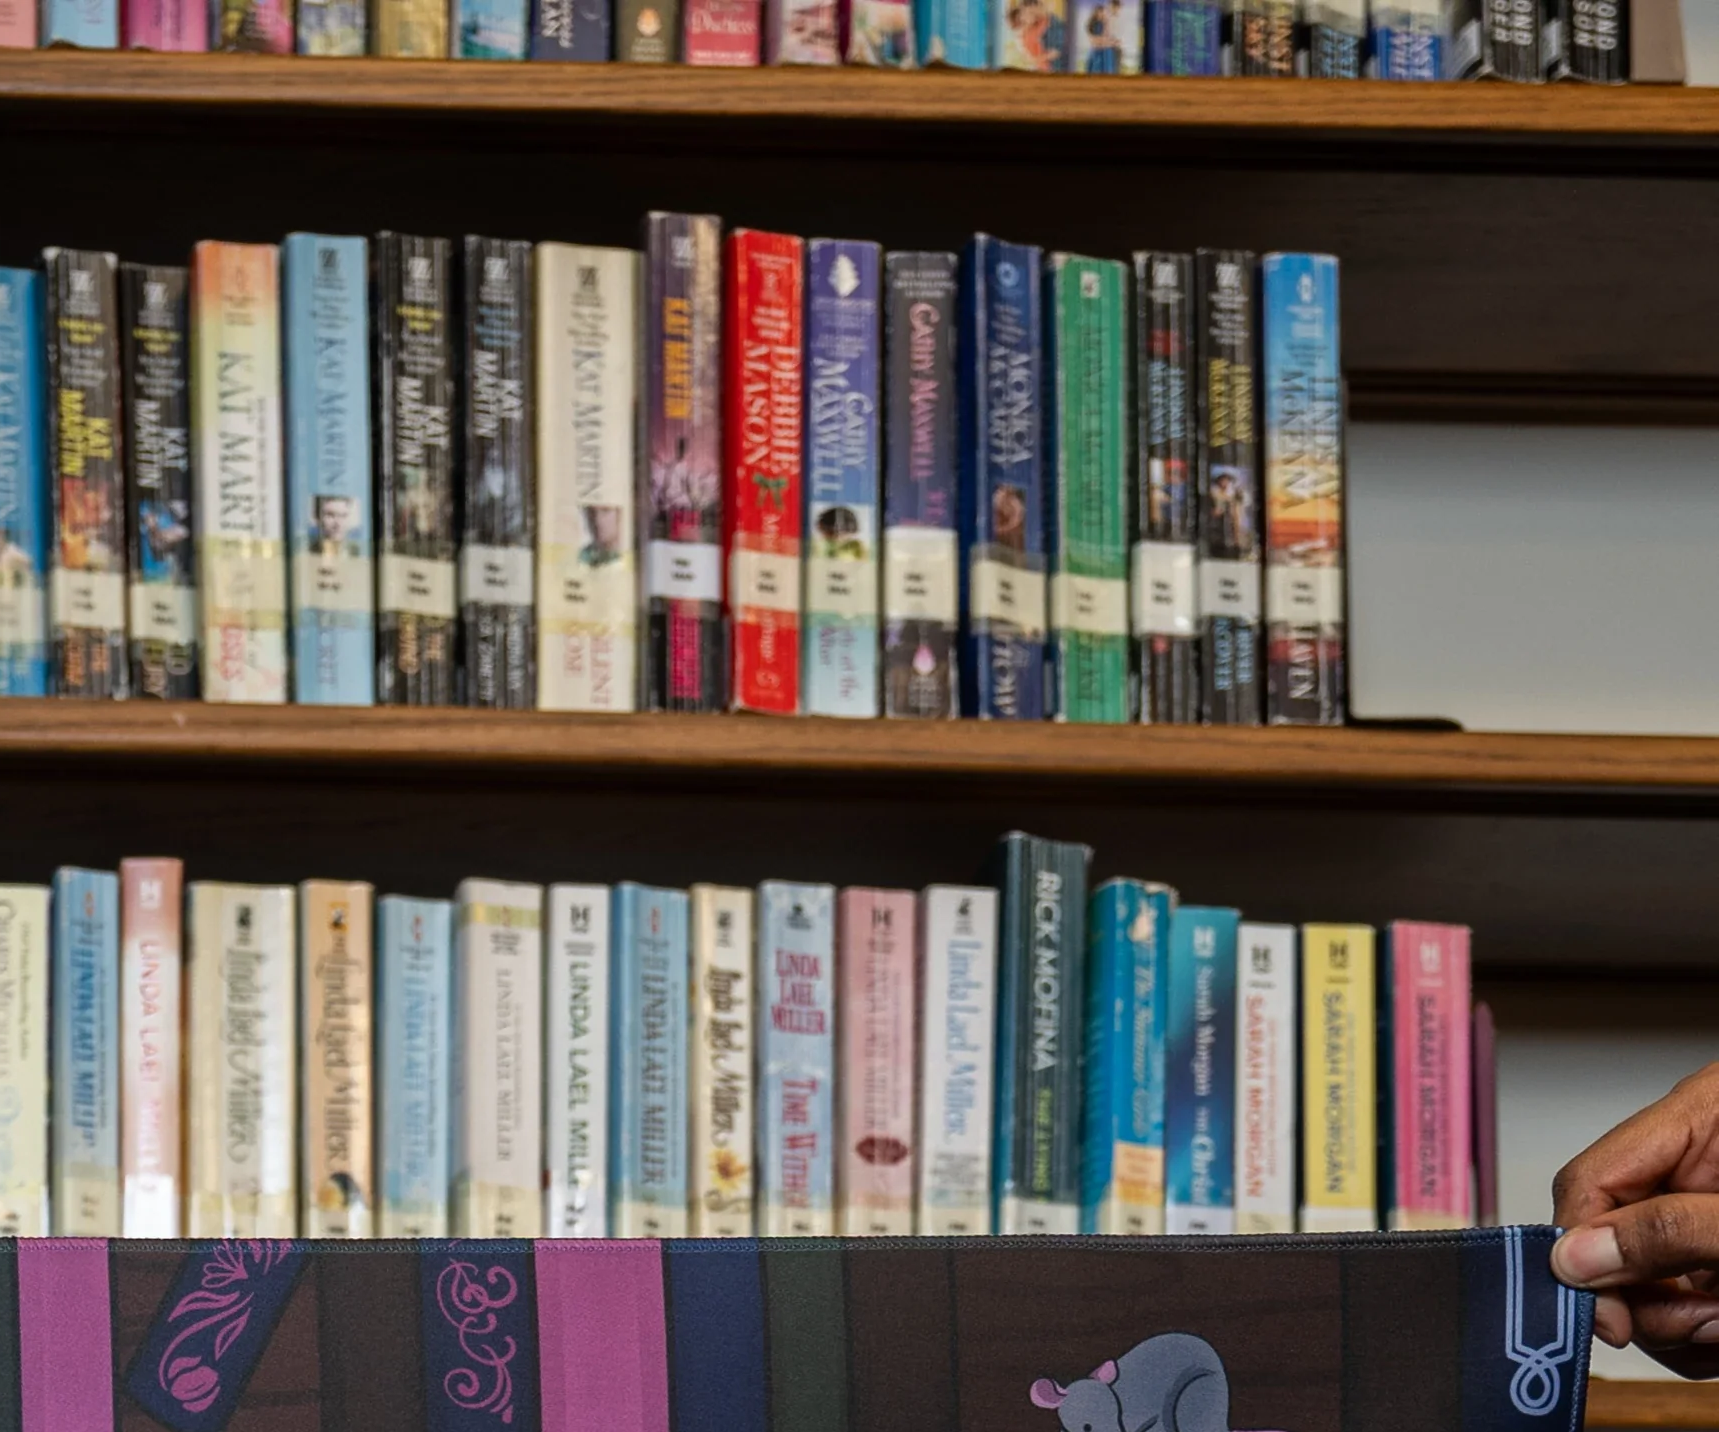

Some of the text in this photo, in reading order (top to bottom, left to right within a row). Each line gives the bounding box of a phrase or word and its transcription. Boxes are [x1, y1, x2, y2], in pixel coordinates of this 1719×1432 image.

[218, 352, 251, 417] KAT
[396, 377, 426, 465] MARTIN
[428, 407, 449, 446] KAT
[474, 352, 501, 437] MARTIN
[501, 380, 523, 418] KAT
[741, 345, 773, 466] MASON
[773, 350, 801, 473] DEBBIE
[813, 358, 849, 493] MAXWELL
[59, 390, 86, 477] MARTIN
[86, 420, 111, 460] KAT
[137, 402, 161, 488] MARTIN
[163, 427, 186, 468] KAT
[910, 378, 939, 480] MAXWELL
[139, 940, 164, 1015] LINDA
[1033, 871, 1061, 1071] RICK MOFINA
[568, 963, 591, 1110] LINDA LAEL
[781, 1078, 818, 1125] TIME
[1246, 993, 1266, 1195] SARAH MORGAN
[1324, 990, 1348, 1192] SARAH MORGAN
[641, 1103, 669, 1185] MILLER
